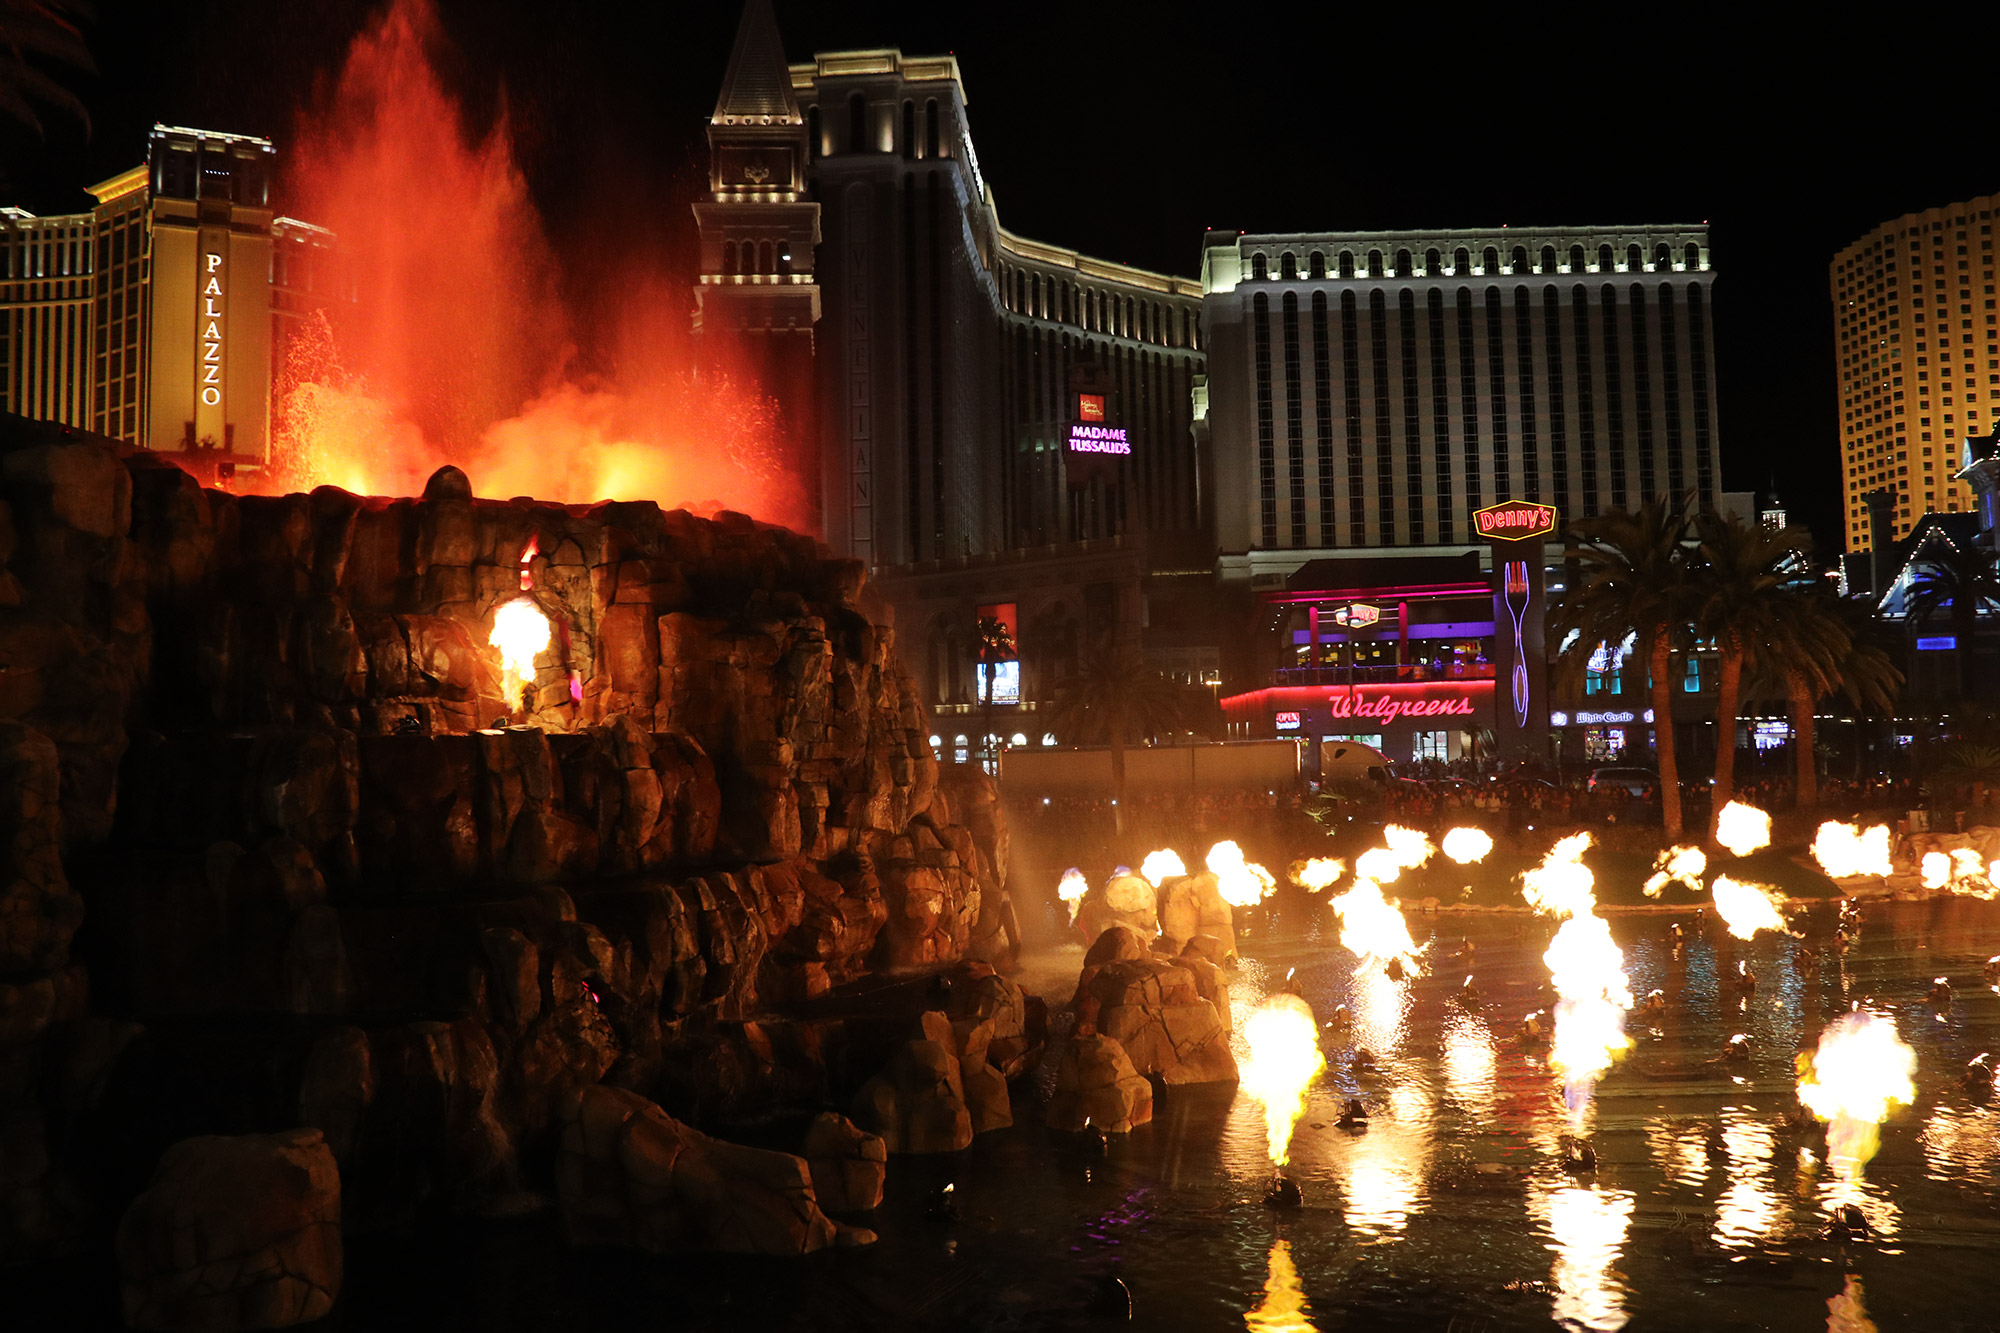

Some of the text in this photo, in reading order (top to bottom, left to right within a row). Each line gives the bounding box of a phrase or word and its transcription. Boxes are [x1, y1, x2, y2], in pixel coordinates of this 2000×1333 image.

[202, 254, 222, 405] PALAZZO
[852, 248, 868, 500] VENETIAN
[1072, 425, 1127, 441] MADAME
[1480, 506, 1551, 531] Denny's
[1278, 712, 1300, 723] OPEN
[1329, 693, 1475, 726] Walgreens
[1576, 711, 1634, 724] White Castle
